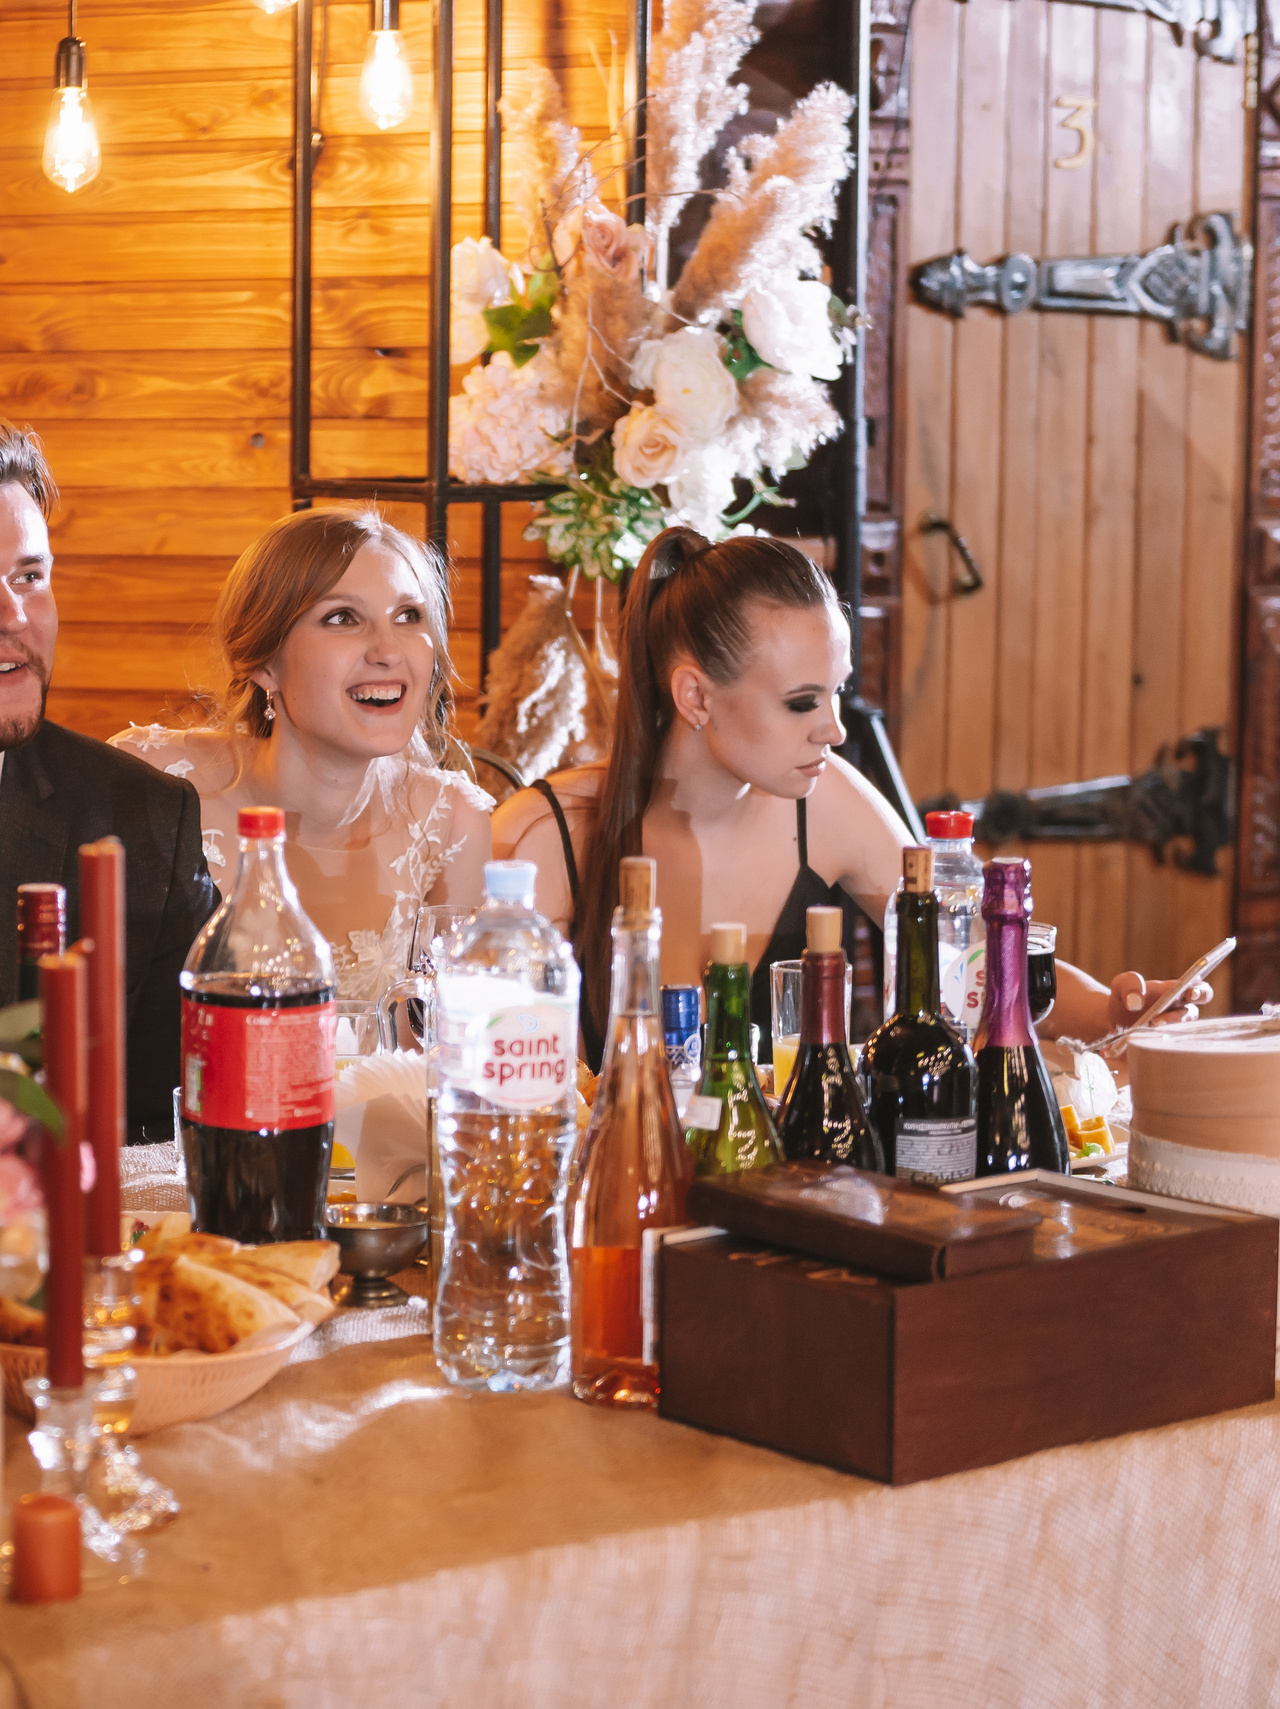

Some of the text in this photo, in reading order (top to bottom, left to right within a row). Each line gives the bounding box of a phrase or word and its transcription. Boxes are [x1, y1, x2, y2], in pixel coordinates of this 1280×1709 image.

[1054, 95, 1096, 169] 3
[493, 1034, 559, 1057] saint
[484, 1059, 565, 1087] spring
